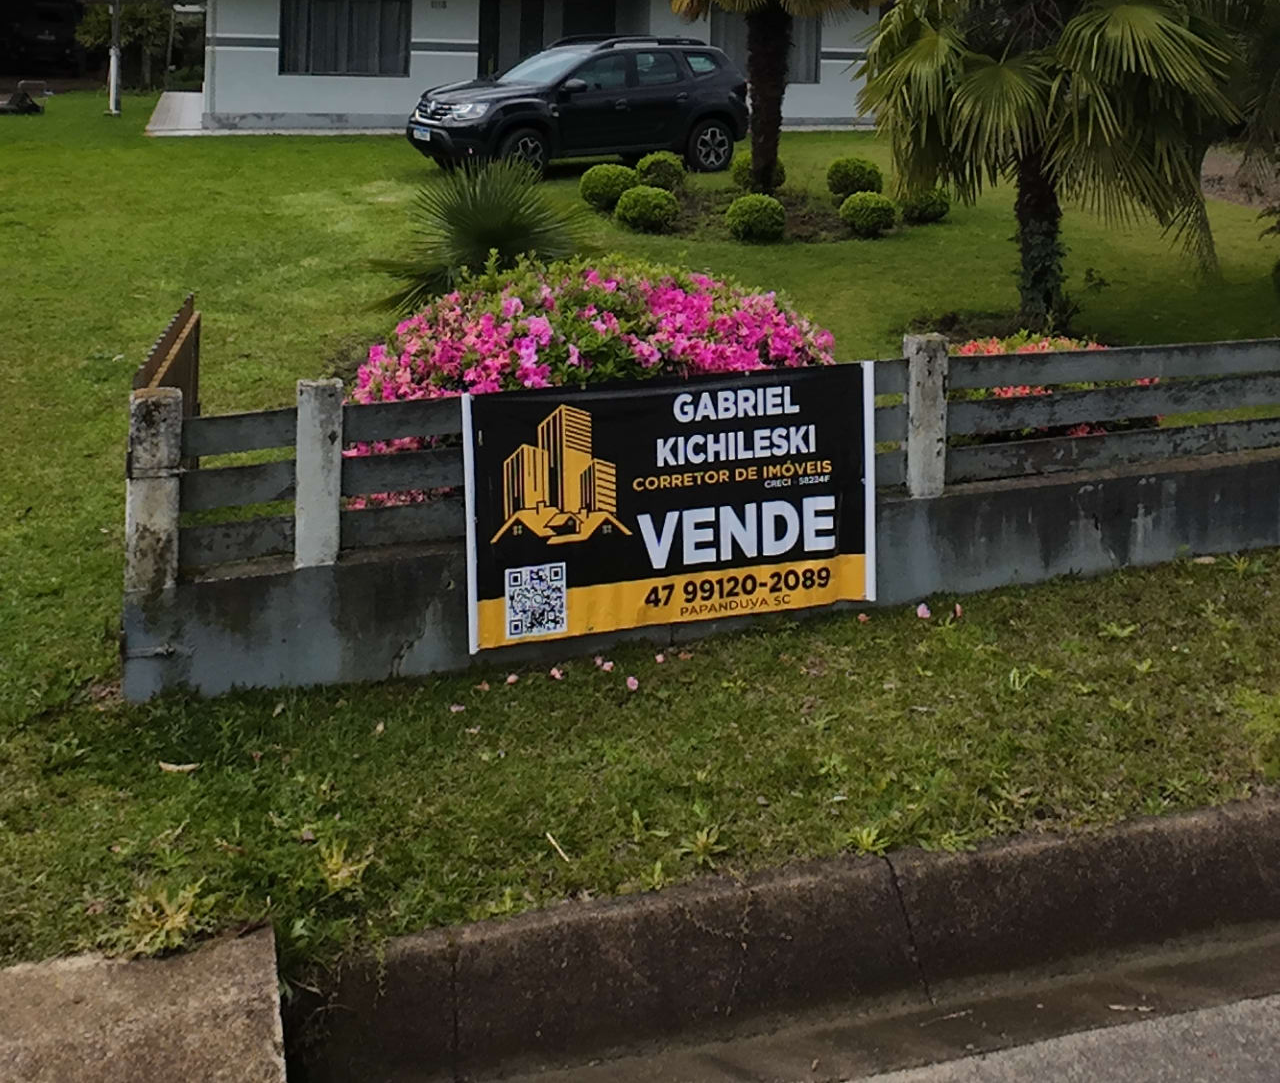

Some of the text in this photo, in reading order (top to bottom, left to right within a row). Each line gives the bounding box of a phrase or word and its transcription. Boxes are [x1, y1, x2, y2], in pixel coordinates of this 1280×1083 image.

[673, 386, 800, 423] GABRIEL
[656, 424, 816, 467] KICHILESKI
[632, 460, 833, 492] CORRETOR DE IMÓVEIS
[764, 477, 792, 489] CRECI
[637, 495, 836, 569] VENDE
[644, 567, 831, 607] 47 99120-2089
[679, 594, 791, 616] PAPANDUVA SC
